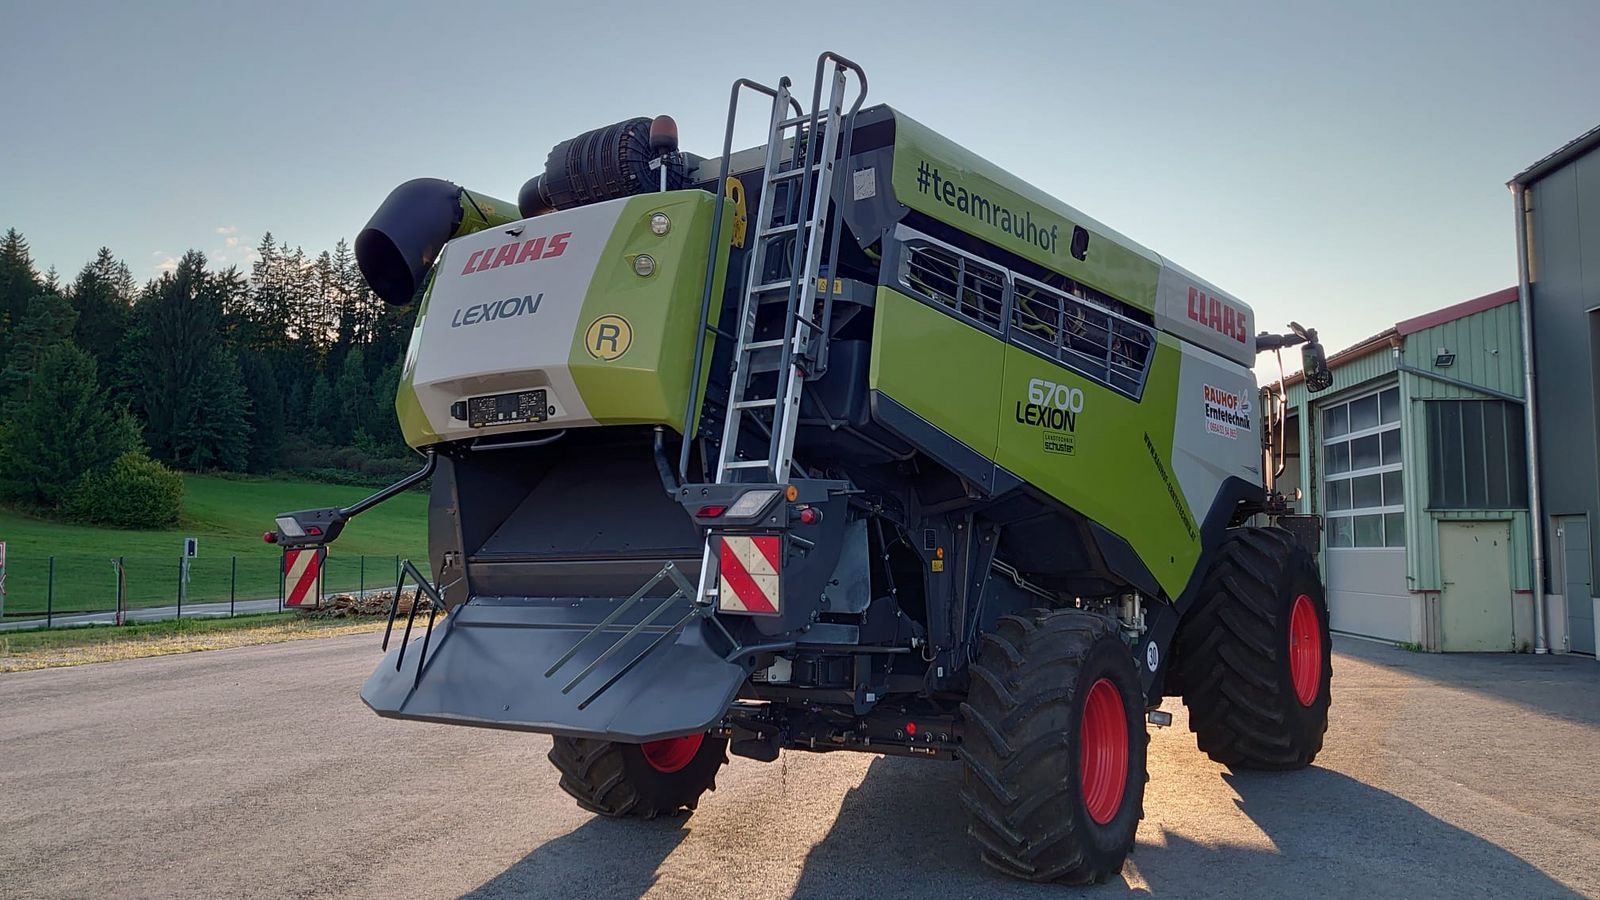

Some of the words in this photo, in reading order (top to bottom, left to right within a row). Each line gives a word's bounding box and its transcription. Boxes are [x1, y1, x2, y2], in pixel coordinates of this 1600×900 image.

[917, 160, 1058, 254] #teamrauhof
[461, 232, 573, 276] CLAAS
[451, 293, 544, 328] LEXION
[1187, 286, 1246, 344] CLAAS
[595, 323, 620, 352] R
[1028, 378, 1084, 413] 6700
[1204, 385, 1238, 410] RAUHOF
[1016, 400, 1076, 433] LEXION
[1205, 403, 1251, 430] Erntetechnik
[1148, 646, 1157, 666] 30
